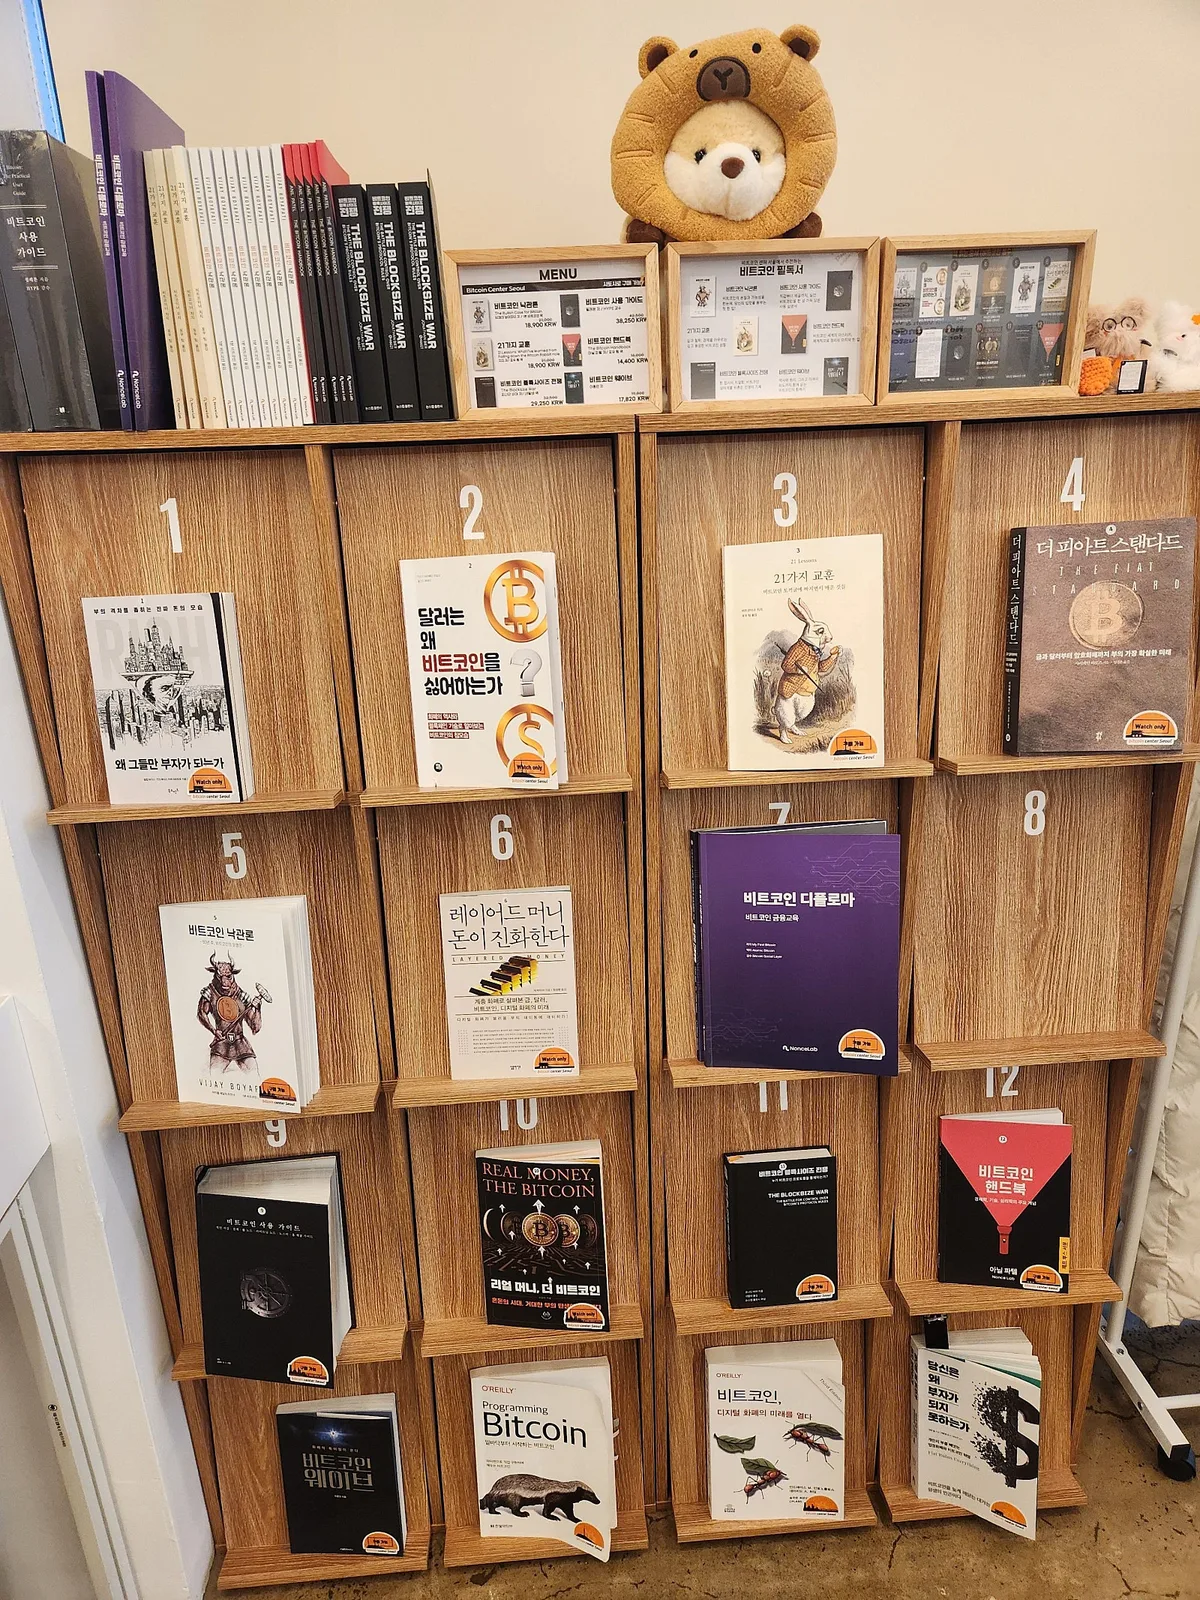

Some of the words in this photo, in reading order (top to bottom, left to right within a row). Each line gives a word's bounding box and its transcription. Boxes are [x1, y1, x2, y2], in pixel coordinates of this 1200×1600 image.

[95, 155, 105, 185] 비트코인
[112, 155, 122, 186] 비트코인
[98, 186, 108, 217] 디플로마
[114, 187, 125, 217] 디플로마
[7, 216, 46, 227] 비트코인
[19, 231, 38, 243] 사용
[350, 223, 362, 249] THE
[383, 221, 395, 247] THE
[414, 221, 427, 247] THE
[17, 247, 47, 258] 가이드
[539, 268, 577, 280] MENU
[740, 266, 774, 276] 비트코인
[777, 265, 803, 275] 필독서
[352, 251, 371, 322] BLOCKSIZE
[384, 249, 405, 320] BLOCKSIZE
[415, 248, 436, 320] BLOCKSIZE
[362, 324, 374, 351] WAR
[394, 322, 406, 349] WAR
[424, 322, 437, 349] WAR
[1060, 456, 1085, 512] 4
[773, 473, 798, 528] 3
[460, 485, 485, 541] 2
[159, 497, 183, 554] 1
[1037, 539, 1053, 558] 더
[774, 571, 808, 584] 21가지
[812, 569, 835, 581] 교훈
[1059, 564, 1098, 577] THE
[1114, 562, 1153, 574] FIAT
[1032, 579, 1180, 596] STANDARD
[418, 607, 465, 627] 달러는
[420, 631, 436, 650] 왜
[422, 652, 501, 672] 비트코인을
[1049, 652, 1072, 660] 달러부터
[424, 676, 503, 696] 싫어하는가
[115, 758, 127, 771] 왜
[128, 758, 158, 770] 그들만
[161, 758, 191, 770] 부자가
[194, 757, 224, 769] 되는가
[768, 802, 790, 825] 7
[1023, 790, 1046, 836] 8
[490, 814, 514, 861] 6
[221, 833, 248, 880] 5
[744, 892, 797, 906] 비트코인
[801, 892, 855, 907] 디플로마
[450, 904, 525, 926] 레이어드
[528, 901, 563, 924] 머니
[773, 914, 799, 922] 금융교육
[189, 925, 224, 938] 비트코인
[226, 928, 255, 942] 낙관론
[448, 927, 486, 950] 돈이
[491, 925, 570, 949] 진화한다
[986, 1066, 1020, 1098] 12
[265, 1120, 287, 1147] 9
[482, 1162, 522, 1179] REAL
[527, 1167, 594, 1182] MONEY,
[759, 1169, 783, 1177] 비트코인
[785, 1167, 814, 1175] 블록사이즈
[979, 1165, 1033, 1181] 비트코인
[483, 1179, 517, 1195] THE
[522, 1184, 595, 1197] BITCOIN
[985, 1180, 1026, 1196] 핸드북
[227, 1219, 256, 1227] 비트코인
[260, 1221, 273, 1229] 사용
[1004, 1267, 1018, 1275] 파텔
[491, 1279, 512, 1291] 리얼
[515, 1281, 539, 1294] 머니,
[542, 1282, 553, 1294] 더
[556, 1285, 600, 1296] 비트코인
[928, 1360, 959, 1378] 당신은
[482, 1385, 514, 1394] O'REILLY
[928, 1374, 940, 1385] 왜
[717, 1389, 782, 1405] 비트코인,
[928, 1386, 959, 1403] 부자가
[482, 1401, 549, 1415] Programming
[717, 1409, 740, 1417] 디지털
[797, 1412, 812, 1420] 열다
[928, 1399, 949, 1413] 되지
[483, 1412, 587, 1448] Bitcoin
[928, 1412, 970, 1433] 못하는가
[302, 1453, 372, 1473] 비트코인
[304, 1469, 375, 1492] 웨이브
